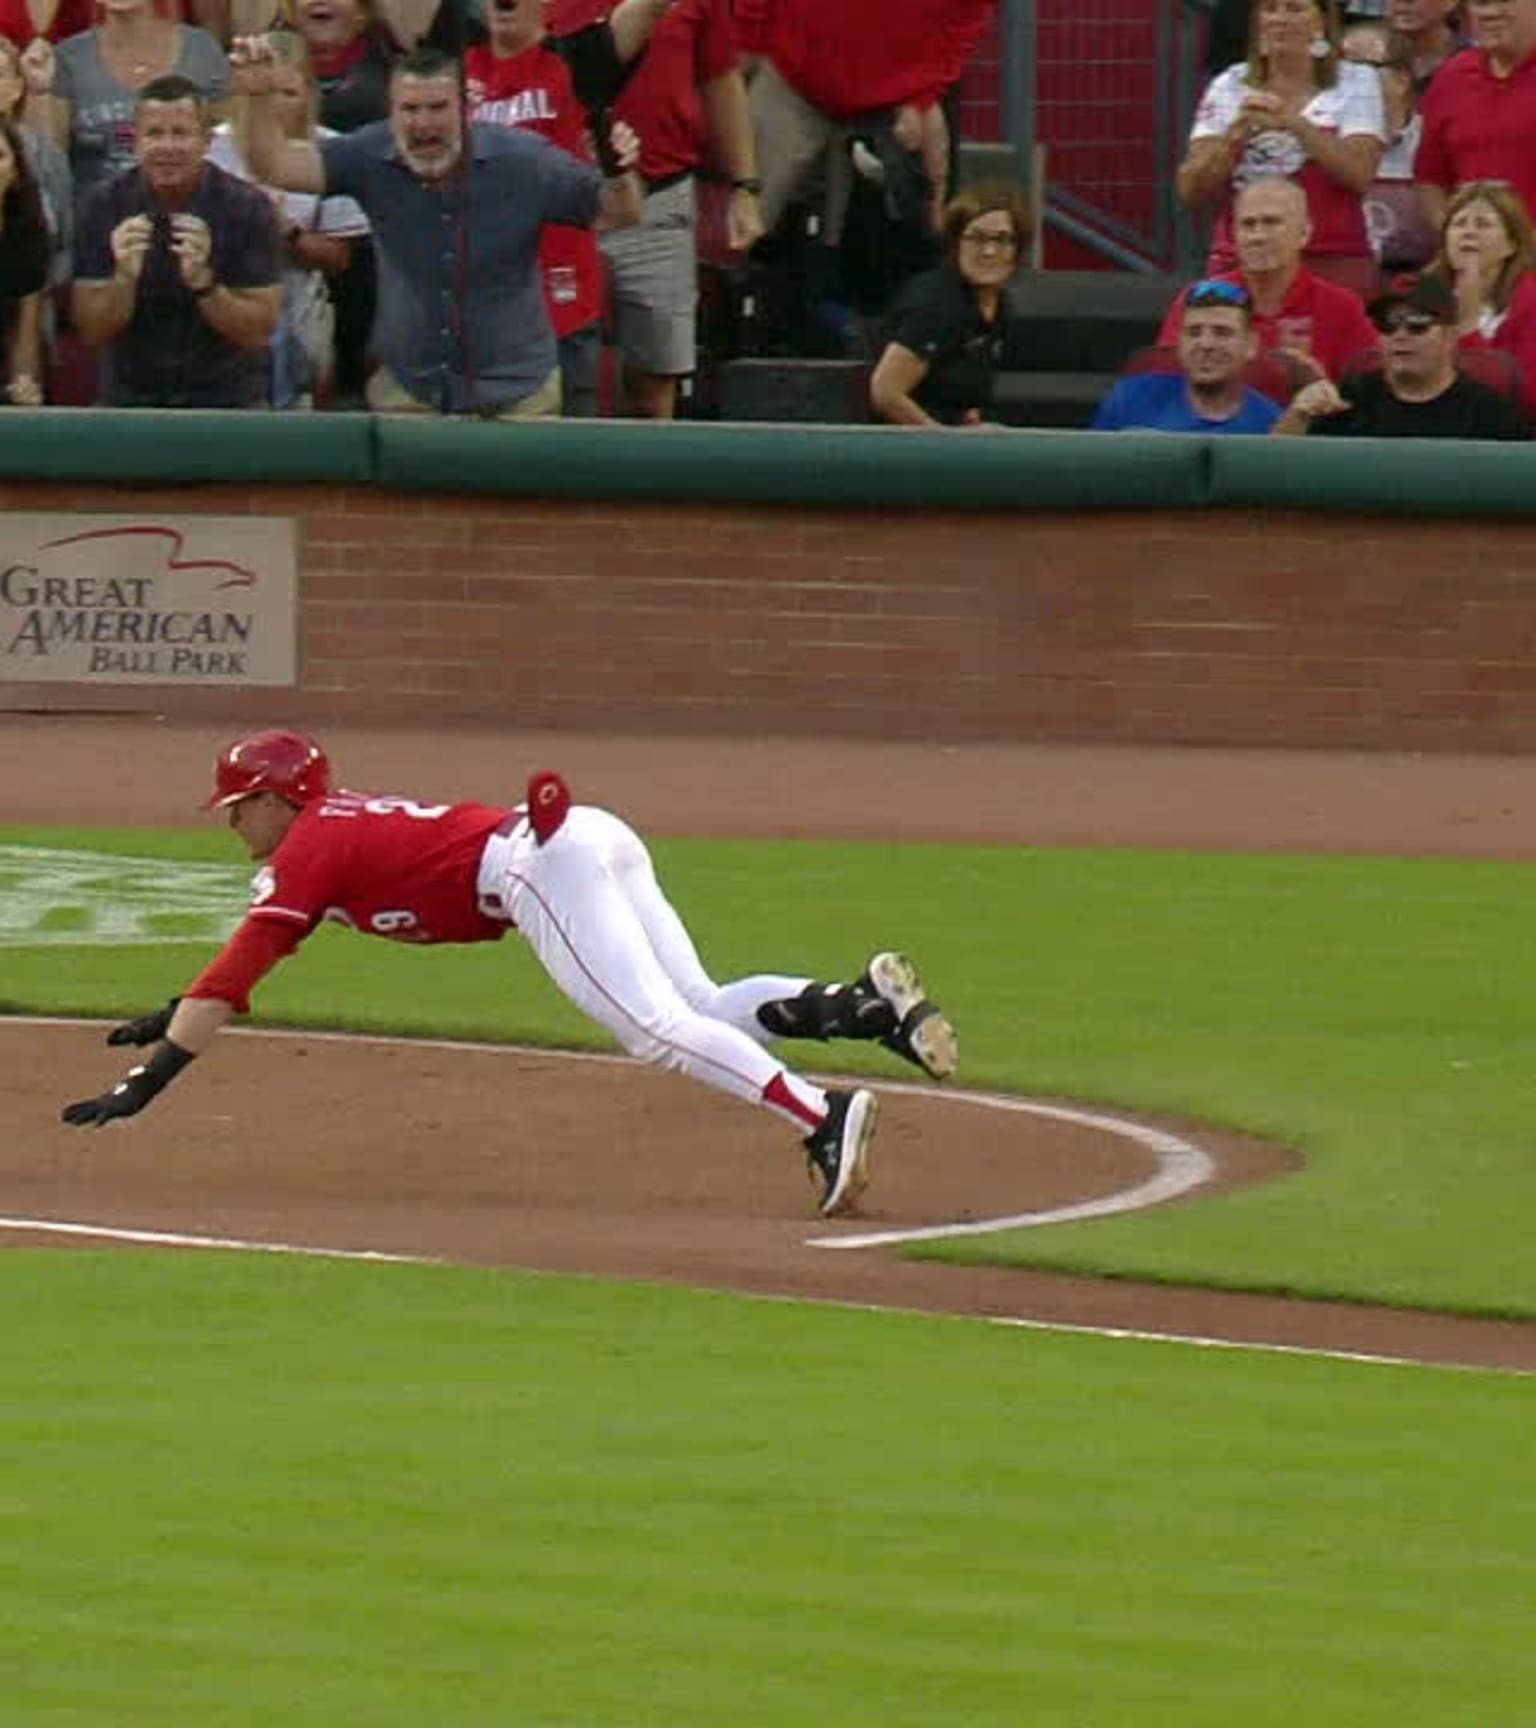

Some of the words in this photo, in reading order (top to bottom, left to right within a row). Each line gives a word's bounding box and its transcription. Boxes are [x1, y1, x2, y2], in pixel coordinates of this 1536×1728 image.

[8, 610, 252, 654] AMERICAN
[88, 645, 159, 674] BALL
[170, 647, 249, 675] PARK
